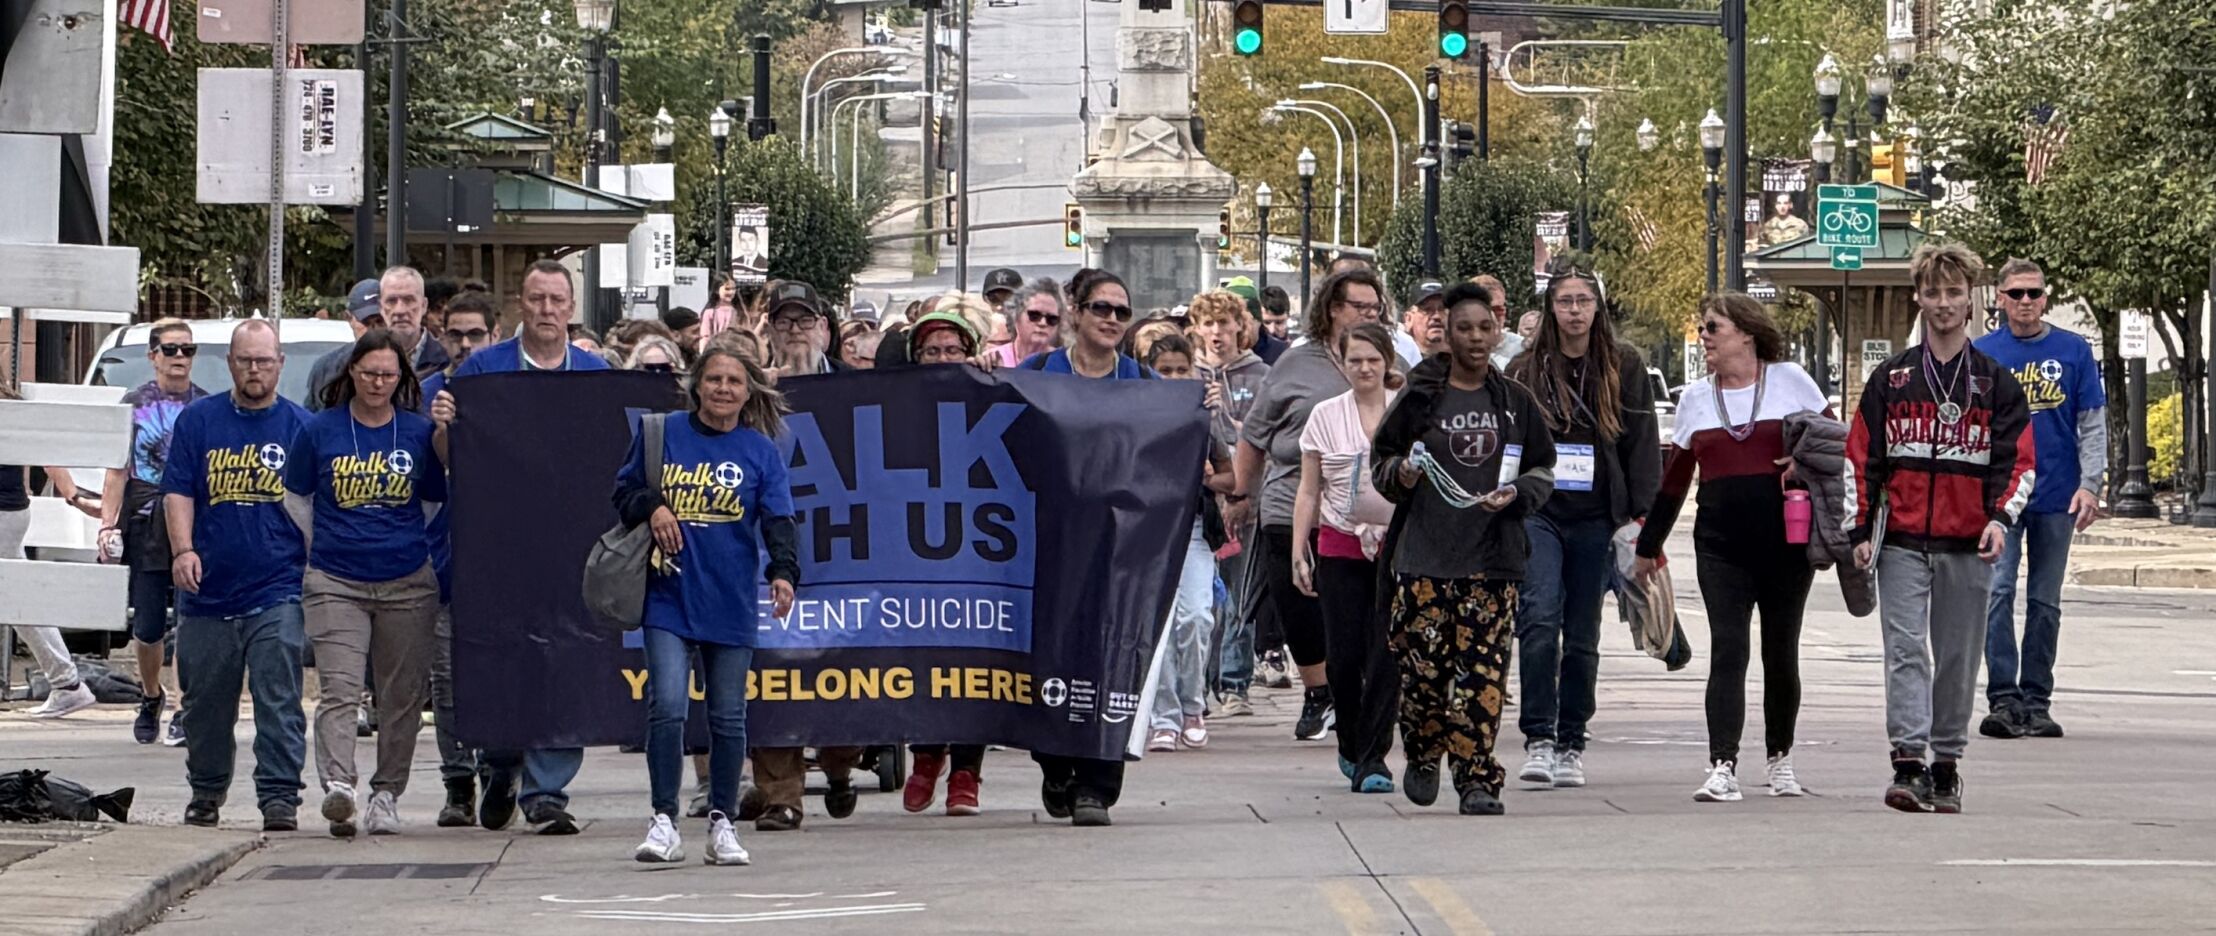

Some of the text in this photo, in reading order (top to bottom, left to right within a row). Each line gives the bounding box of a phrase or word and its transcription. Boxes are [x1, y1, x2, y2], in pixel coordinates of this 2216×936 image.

[1842, 188, 1856, 198] TO
[1845, 234, 1872, 244] ROUTE
[1863, 352, 1889, 361] STOP
[1866, 342, 1887, 351] BUS
[2010, 361, 2041, 384] alk
[206, 444, 261, 472] Walk
[625, 402, 1034, 492] ALK
[331, 451, 389, 476] Walk
[661, 462, 716, 489] Walk
[206, 467, 284, 496] With Us
[332, 473, 413, 500] With Us
[712, 485, 742, 514] Us
[907, 502, 1018, 563] US
[757, 597, 1014, 633] EVENT SUICIDE
[621, 668, 707, 702] YU
[744, 667, 914, 702] BELONG
[931, 667, 1033, 705] HERE
